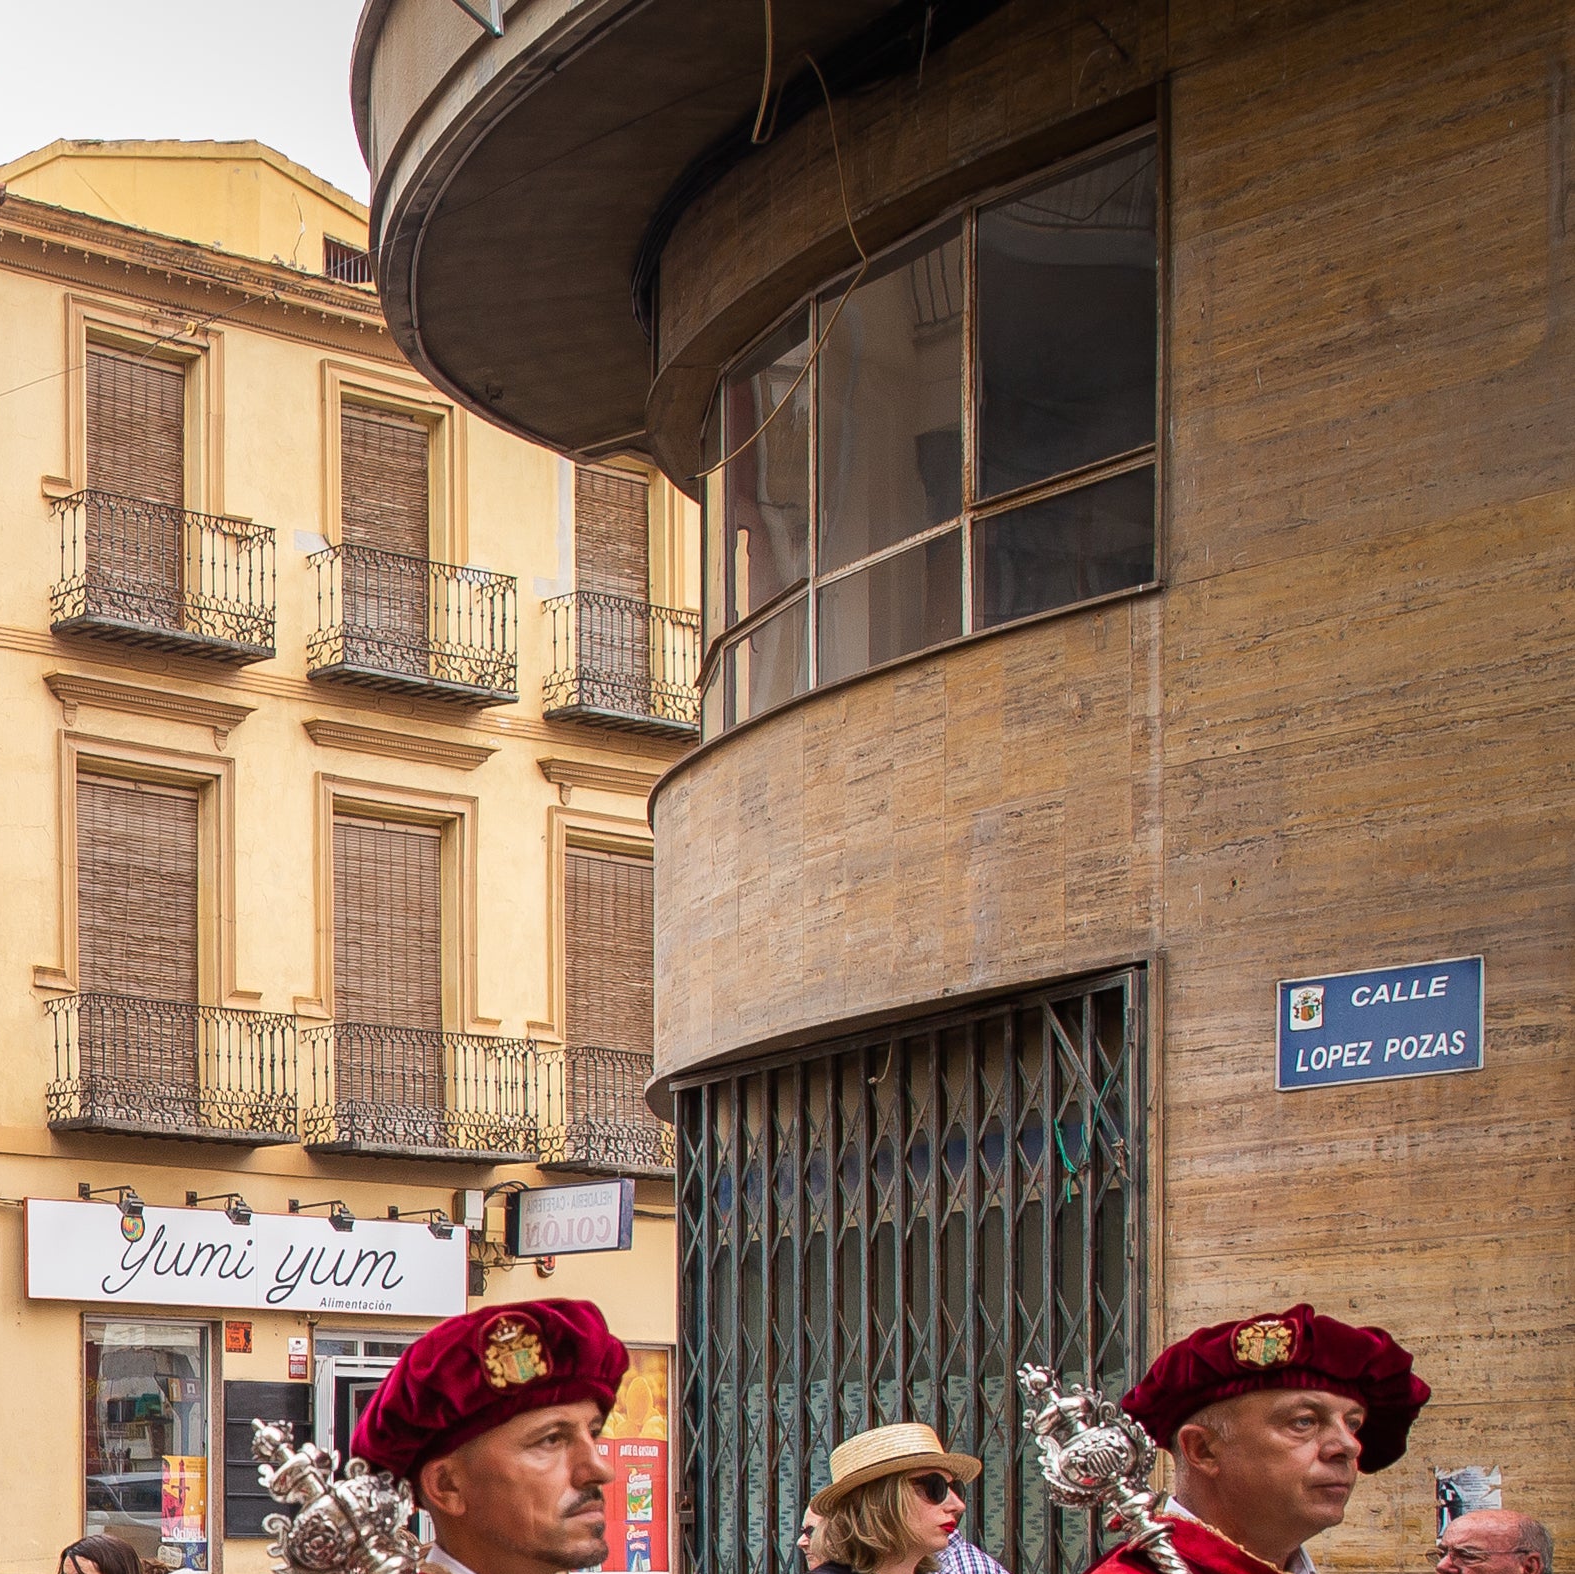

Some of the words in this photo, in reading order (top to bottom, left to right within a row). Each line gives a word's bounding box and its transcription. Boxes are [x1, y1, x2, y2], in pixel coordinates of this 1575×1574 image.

[1351, 975, 1449, 1007] CALLE
[1295, 1040, 1373, 1073] LOPEZ
[1383, 1030, 1467, 1063] POZAS
[318, 1296, 392, 1312] Alimentación
